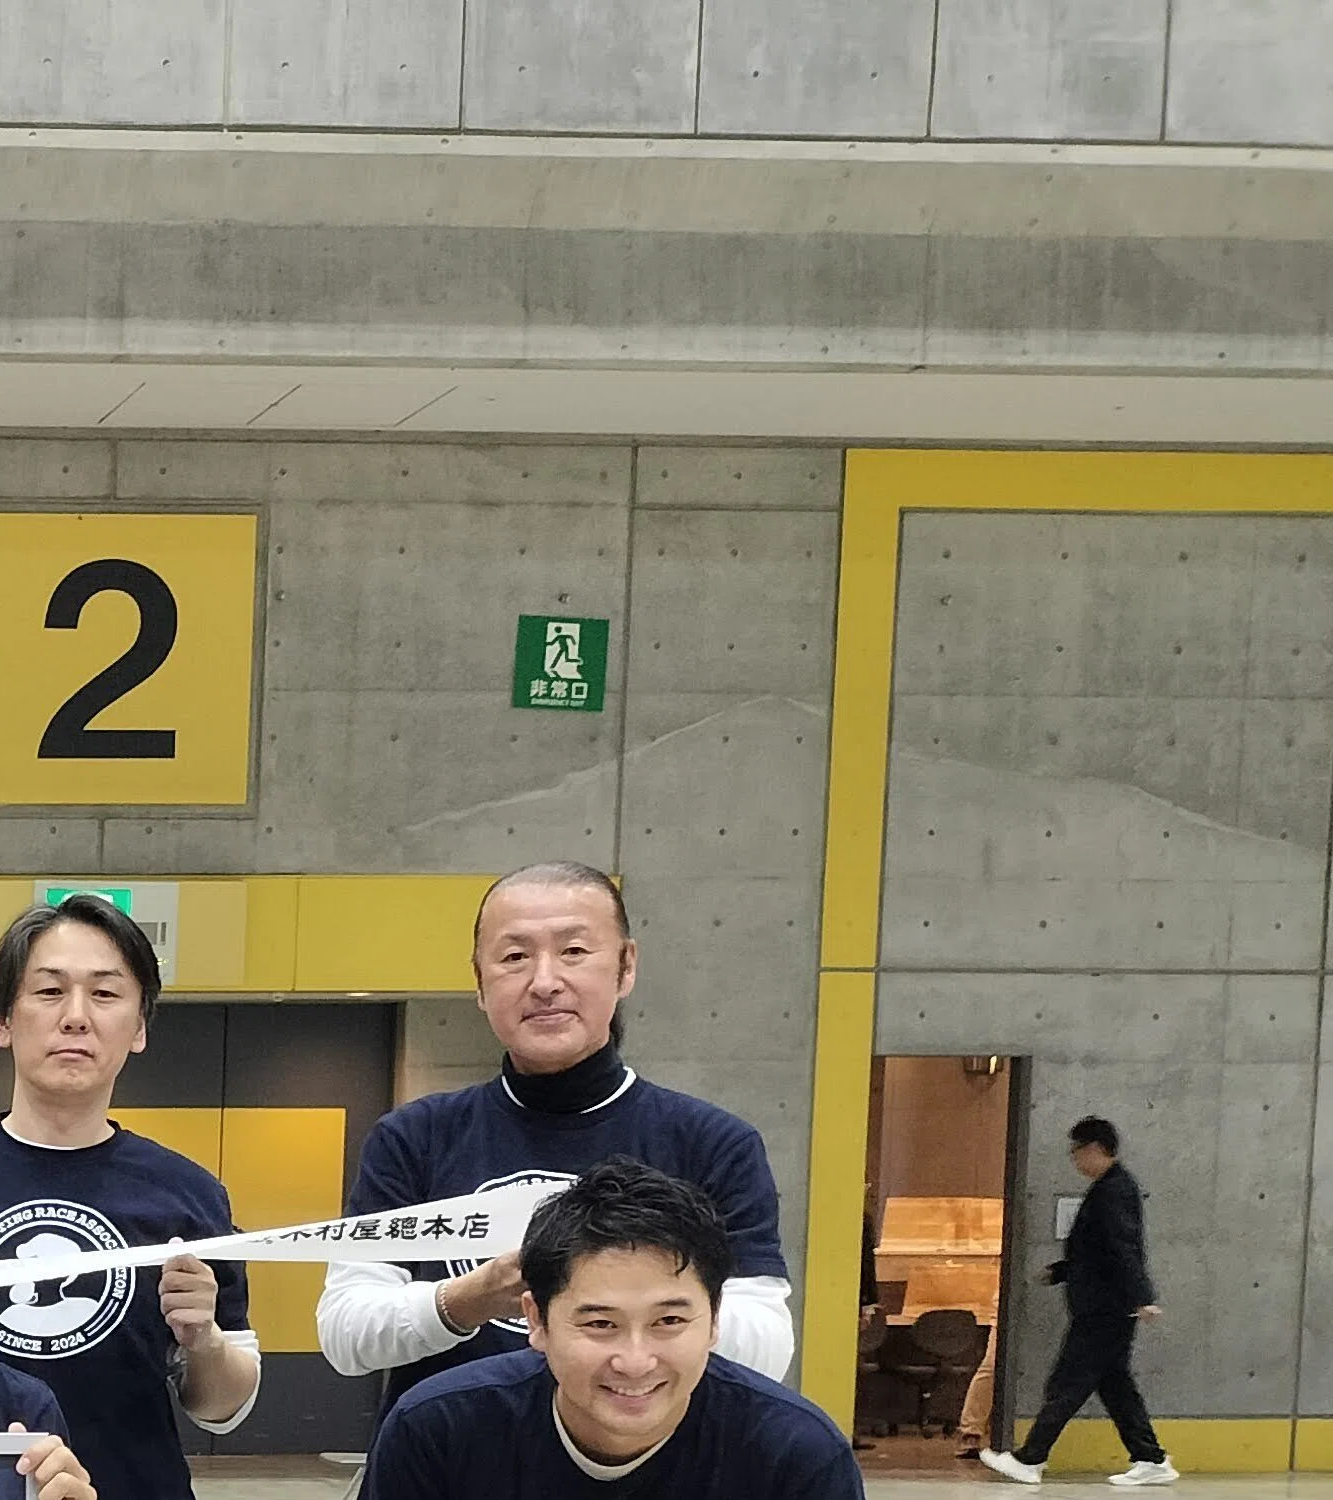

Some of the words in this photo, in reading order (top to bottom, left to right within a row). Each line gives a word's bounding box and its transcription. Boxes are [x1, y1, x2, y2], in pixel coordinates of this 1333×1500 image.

[37, 558, 178, 759] 2
[529, 678, 589, 699] 非常口
[34, 1206, 77, 1222] RACE
[50, 1331, 86, 1352] 2024
